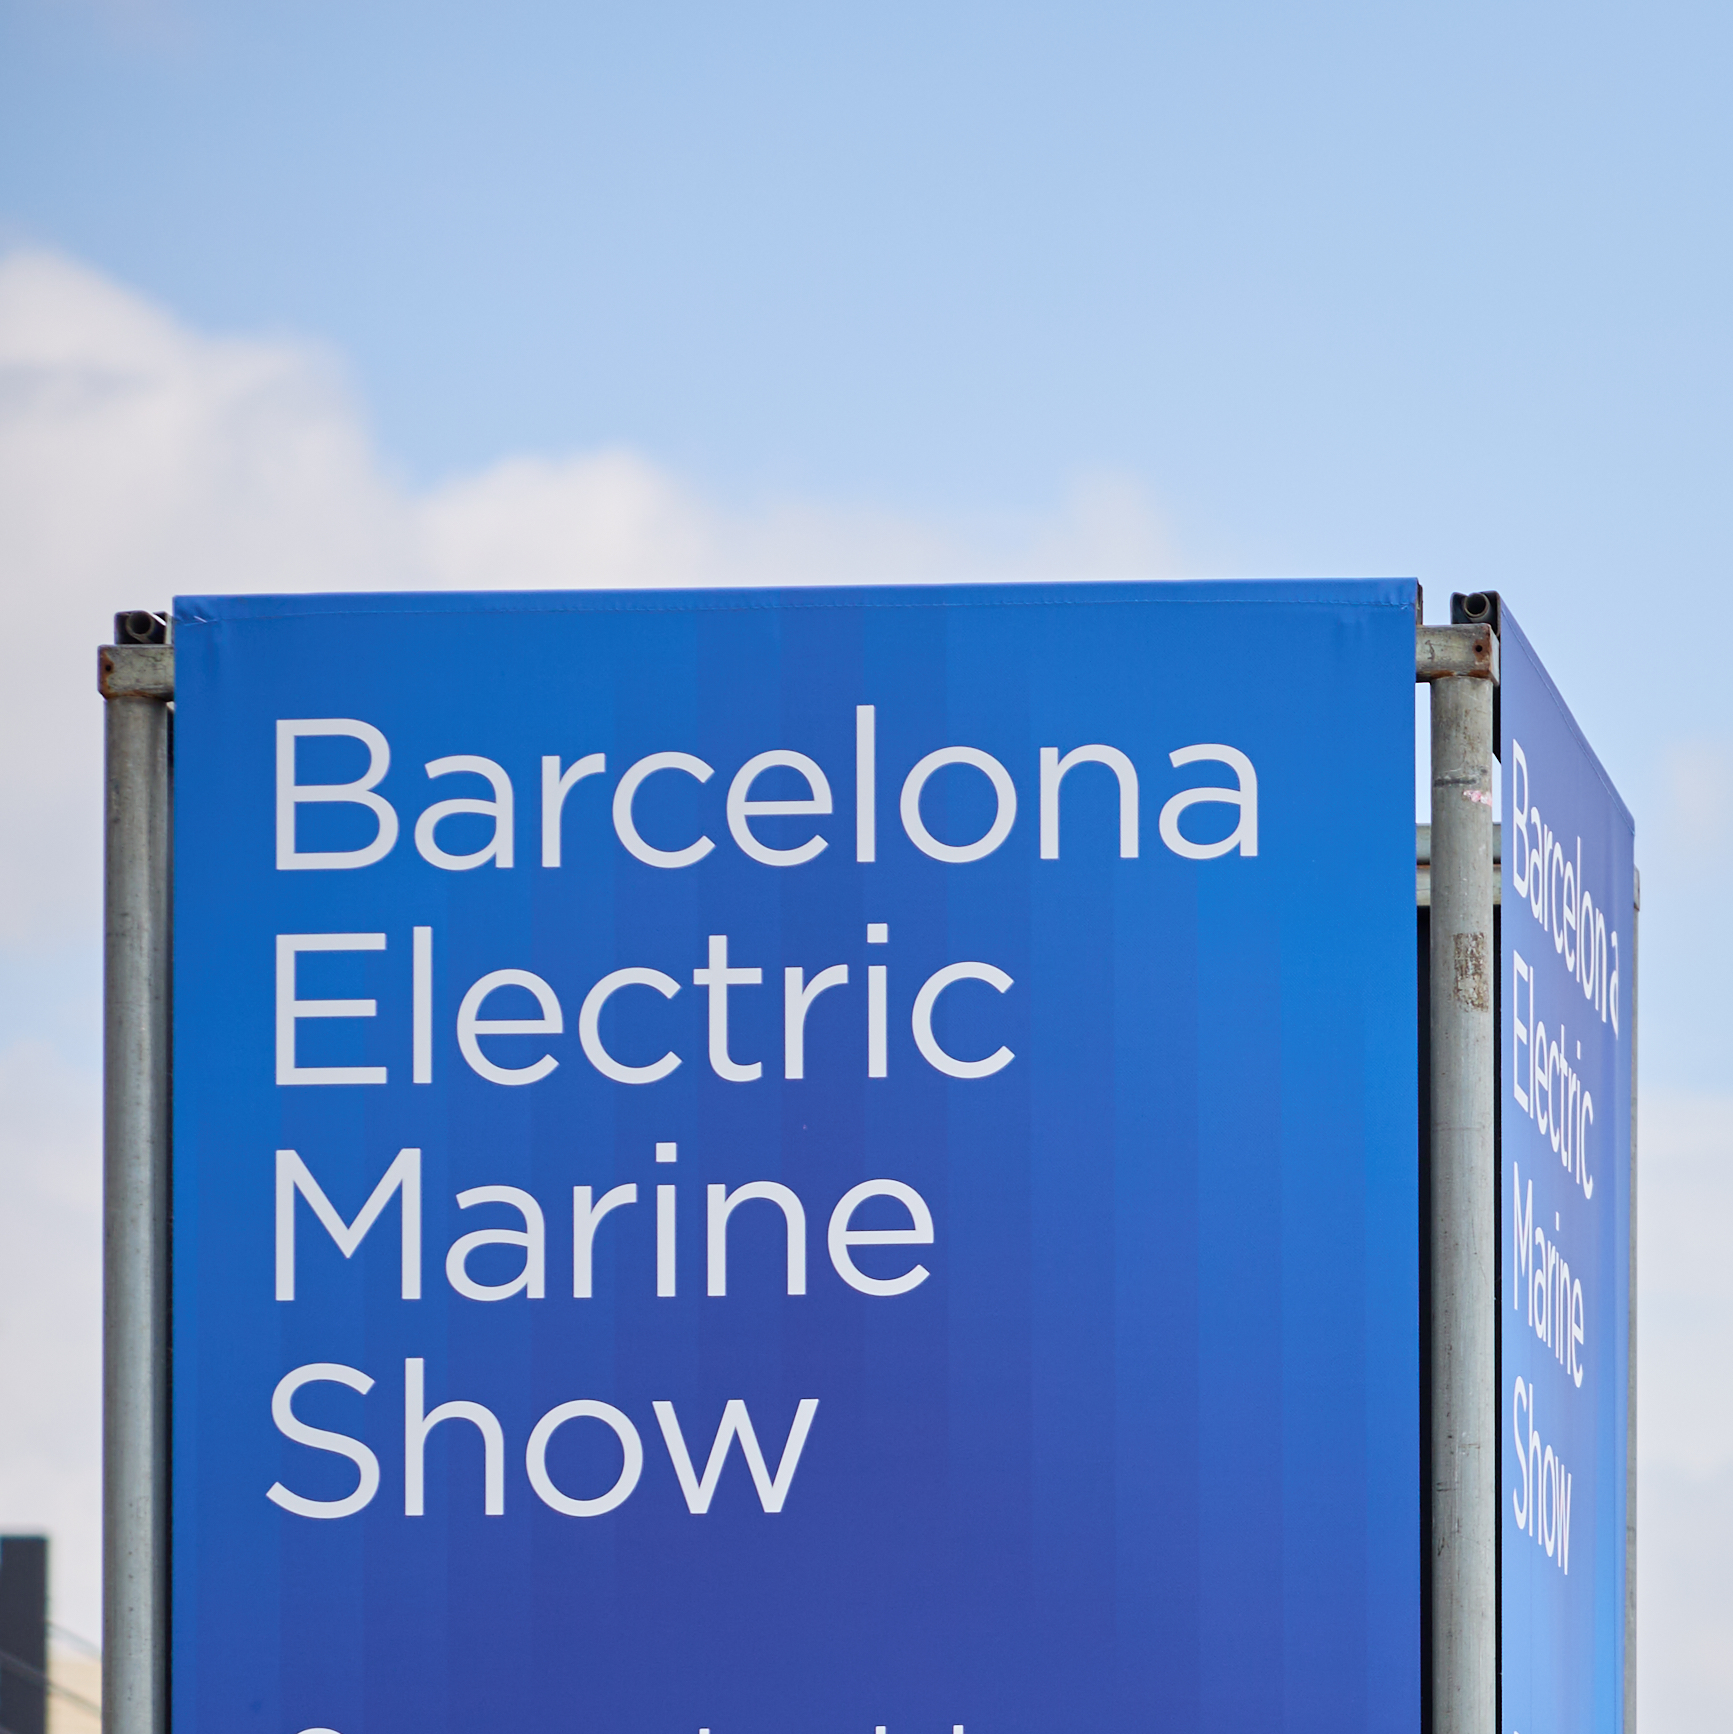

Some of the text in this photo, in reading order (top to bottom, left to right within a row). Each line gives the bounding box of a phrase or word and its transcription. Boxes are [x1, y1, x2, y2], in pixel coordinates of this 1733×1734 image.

[277, 705, 1257, 870] Barcelona
[1512, 737, 1619, 1041] Barcelona
[276, 923, 1014, 1085] Electric
[1513, 949, 1594, 1201] Electric
[276, 1143, 934, 1301] Marine
[1513, 1161, 1584, 1389] Marine
[266, 1358, 819, 1518] Show
[1512, 1374, 1572, 1576] Show
